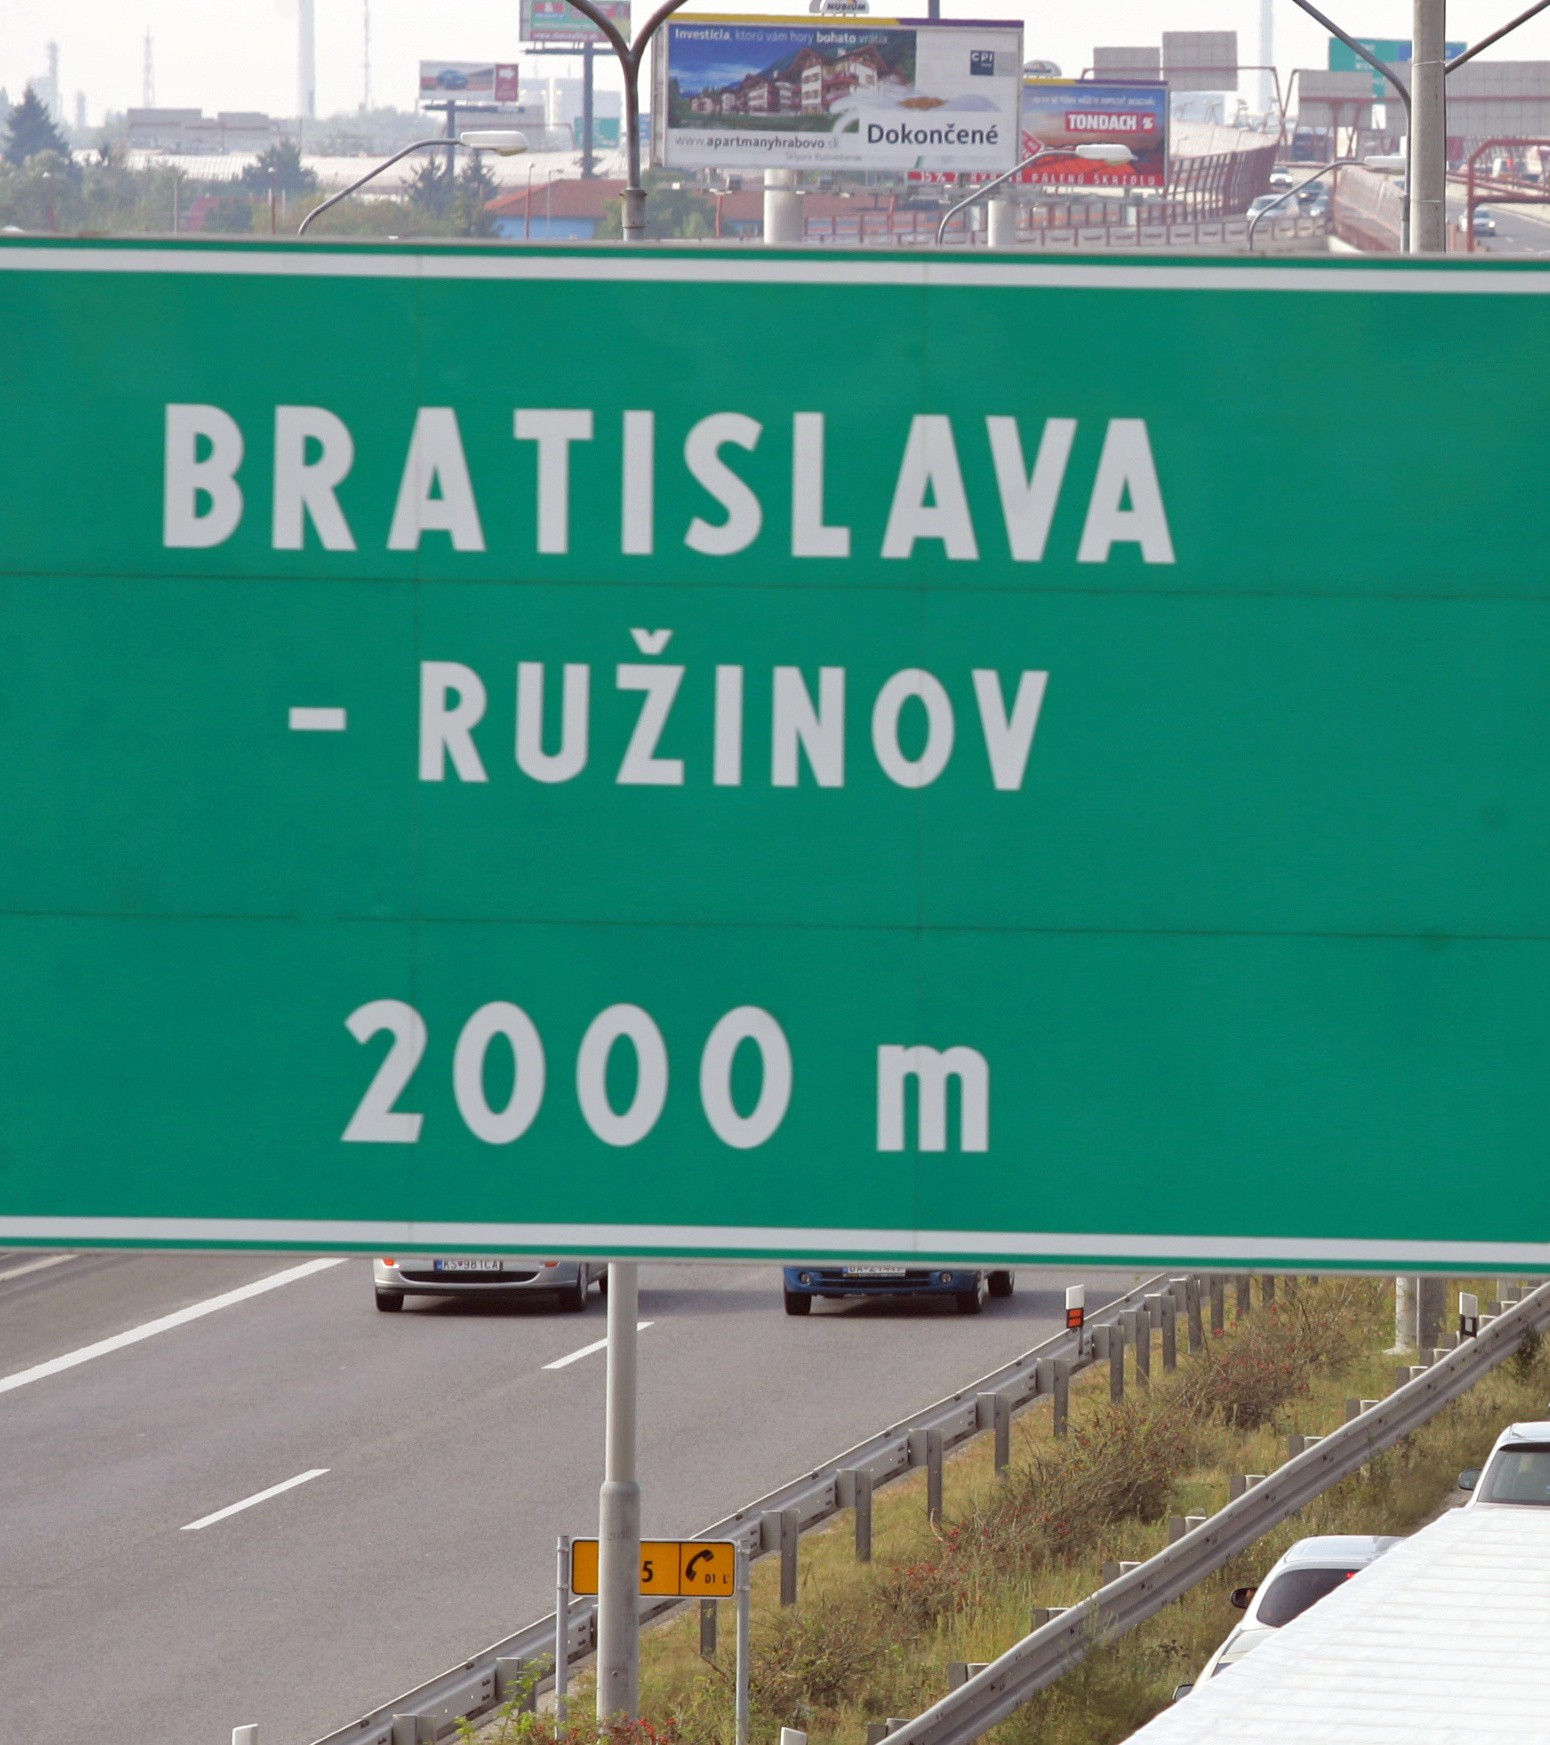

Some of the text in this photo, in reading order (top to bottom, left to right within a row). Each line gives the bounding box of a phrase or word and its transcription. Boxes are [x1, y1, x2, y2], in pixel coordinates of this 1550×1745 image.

[790, 31, 814, 45] hory
[816, 32, 856, 44] bohato
[971, 52, 993, 61] CPI
[1067, 114, 1138, 130] TONDACH
[675, 133, 839, 151] www.apartmanyhrabovo.sk
[867, 123, 1000, 145] Dokončené
[162, 403, 1177, 566] BRATISLAVA
[417, 628, 1049, 791] RUŽINOV
[340, 999, 991, 1153] 2000 m
[641, 1560, 654, 1583] 5
[704, 1573, 716, 1584] D1
